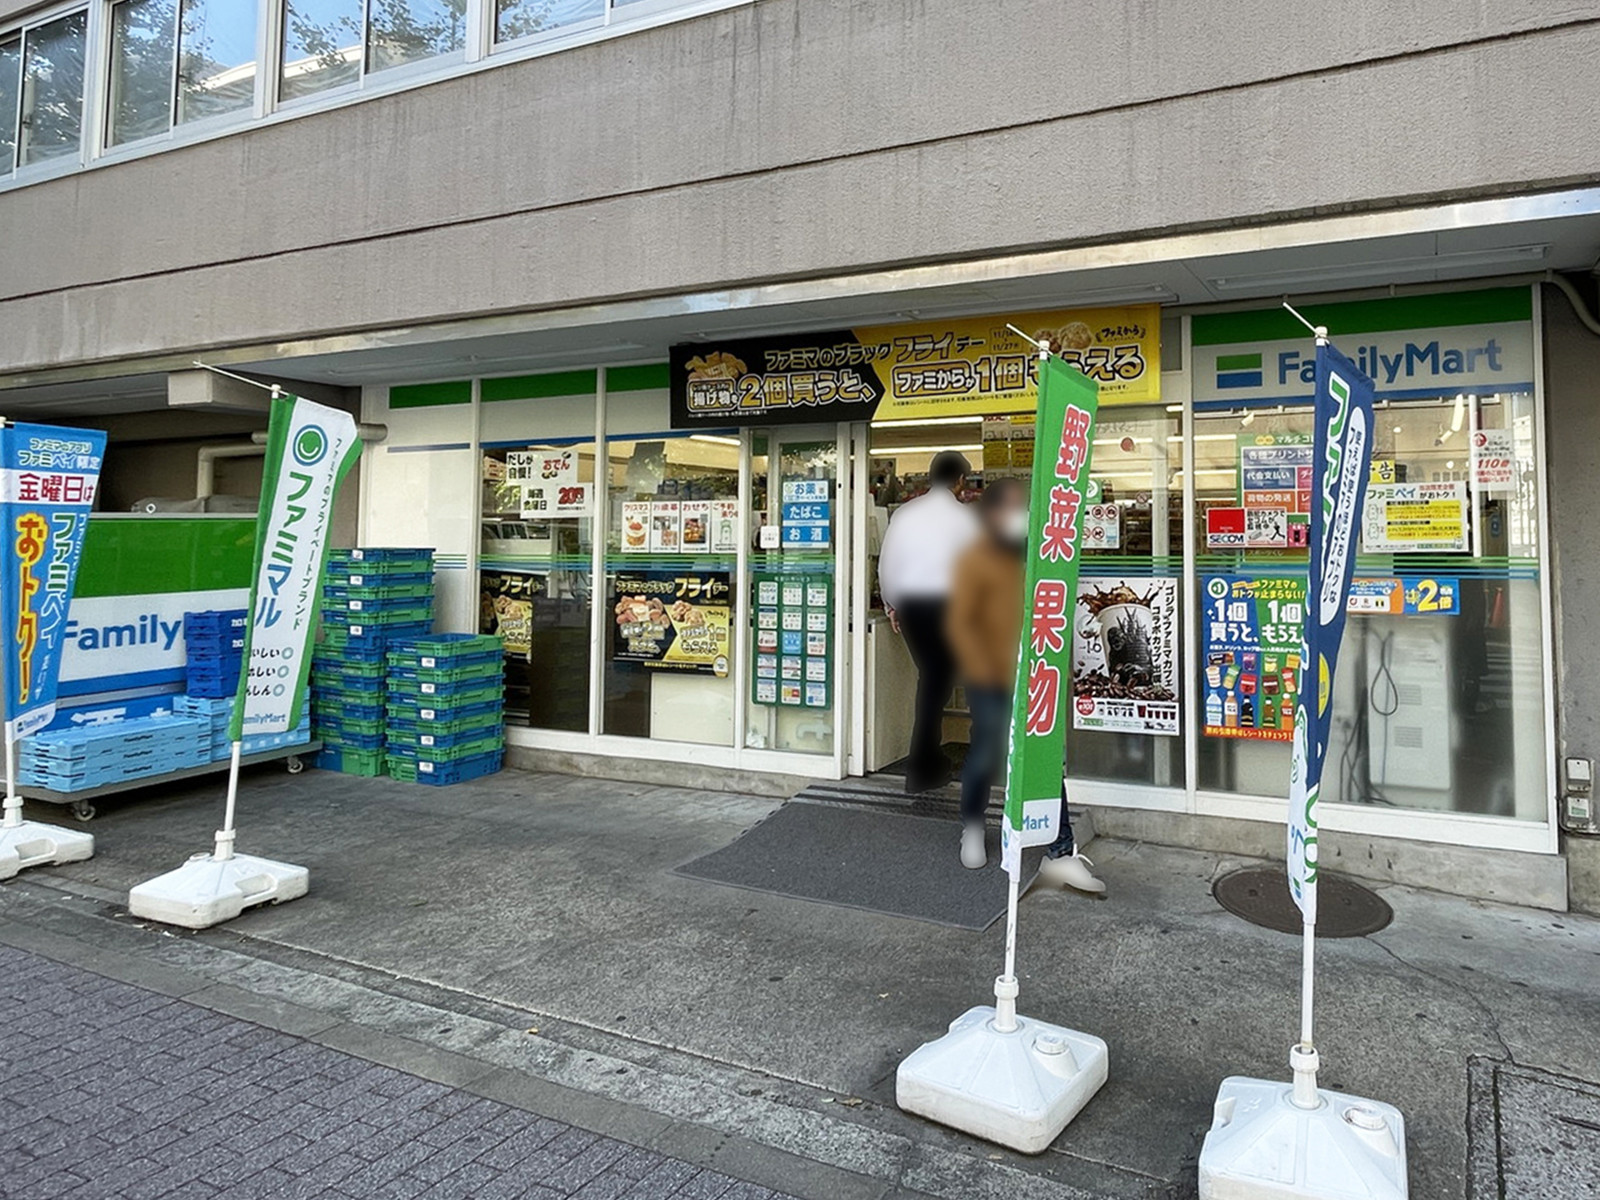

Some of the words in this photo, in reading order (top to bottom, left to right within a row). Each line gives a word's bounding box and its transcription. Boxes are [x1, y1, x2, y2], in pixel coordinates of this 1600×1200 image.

[1278, 339, 1502, 384] FailyMart
[543, 459, 571, 471] おでん
[1370, 461, 1394, 480] 告
[18, 473, 94, 502] 金曜日は
[1368, 487, 1417, 499] ファミペイ
[789, 506, 823, 519] たばこ
[1209, 534, 1245, 543] SECOM
[254, 471, 313, 629] ファミマル
[1214, 599, 1248, 622] 1個
[1267, 600, 1302, 623] 1個
[61, 612, 182, 652] Family
[1210, 622, 1259, 642] 買うと、
[1261, 623, 1303, 643] もらえ
[1023, 815, 1049, 831] Mart
